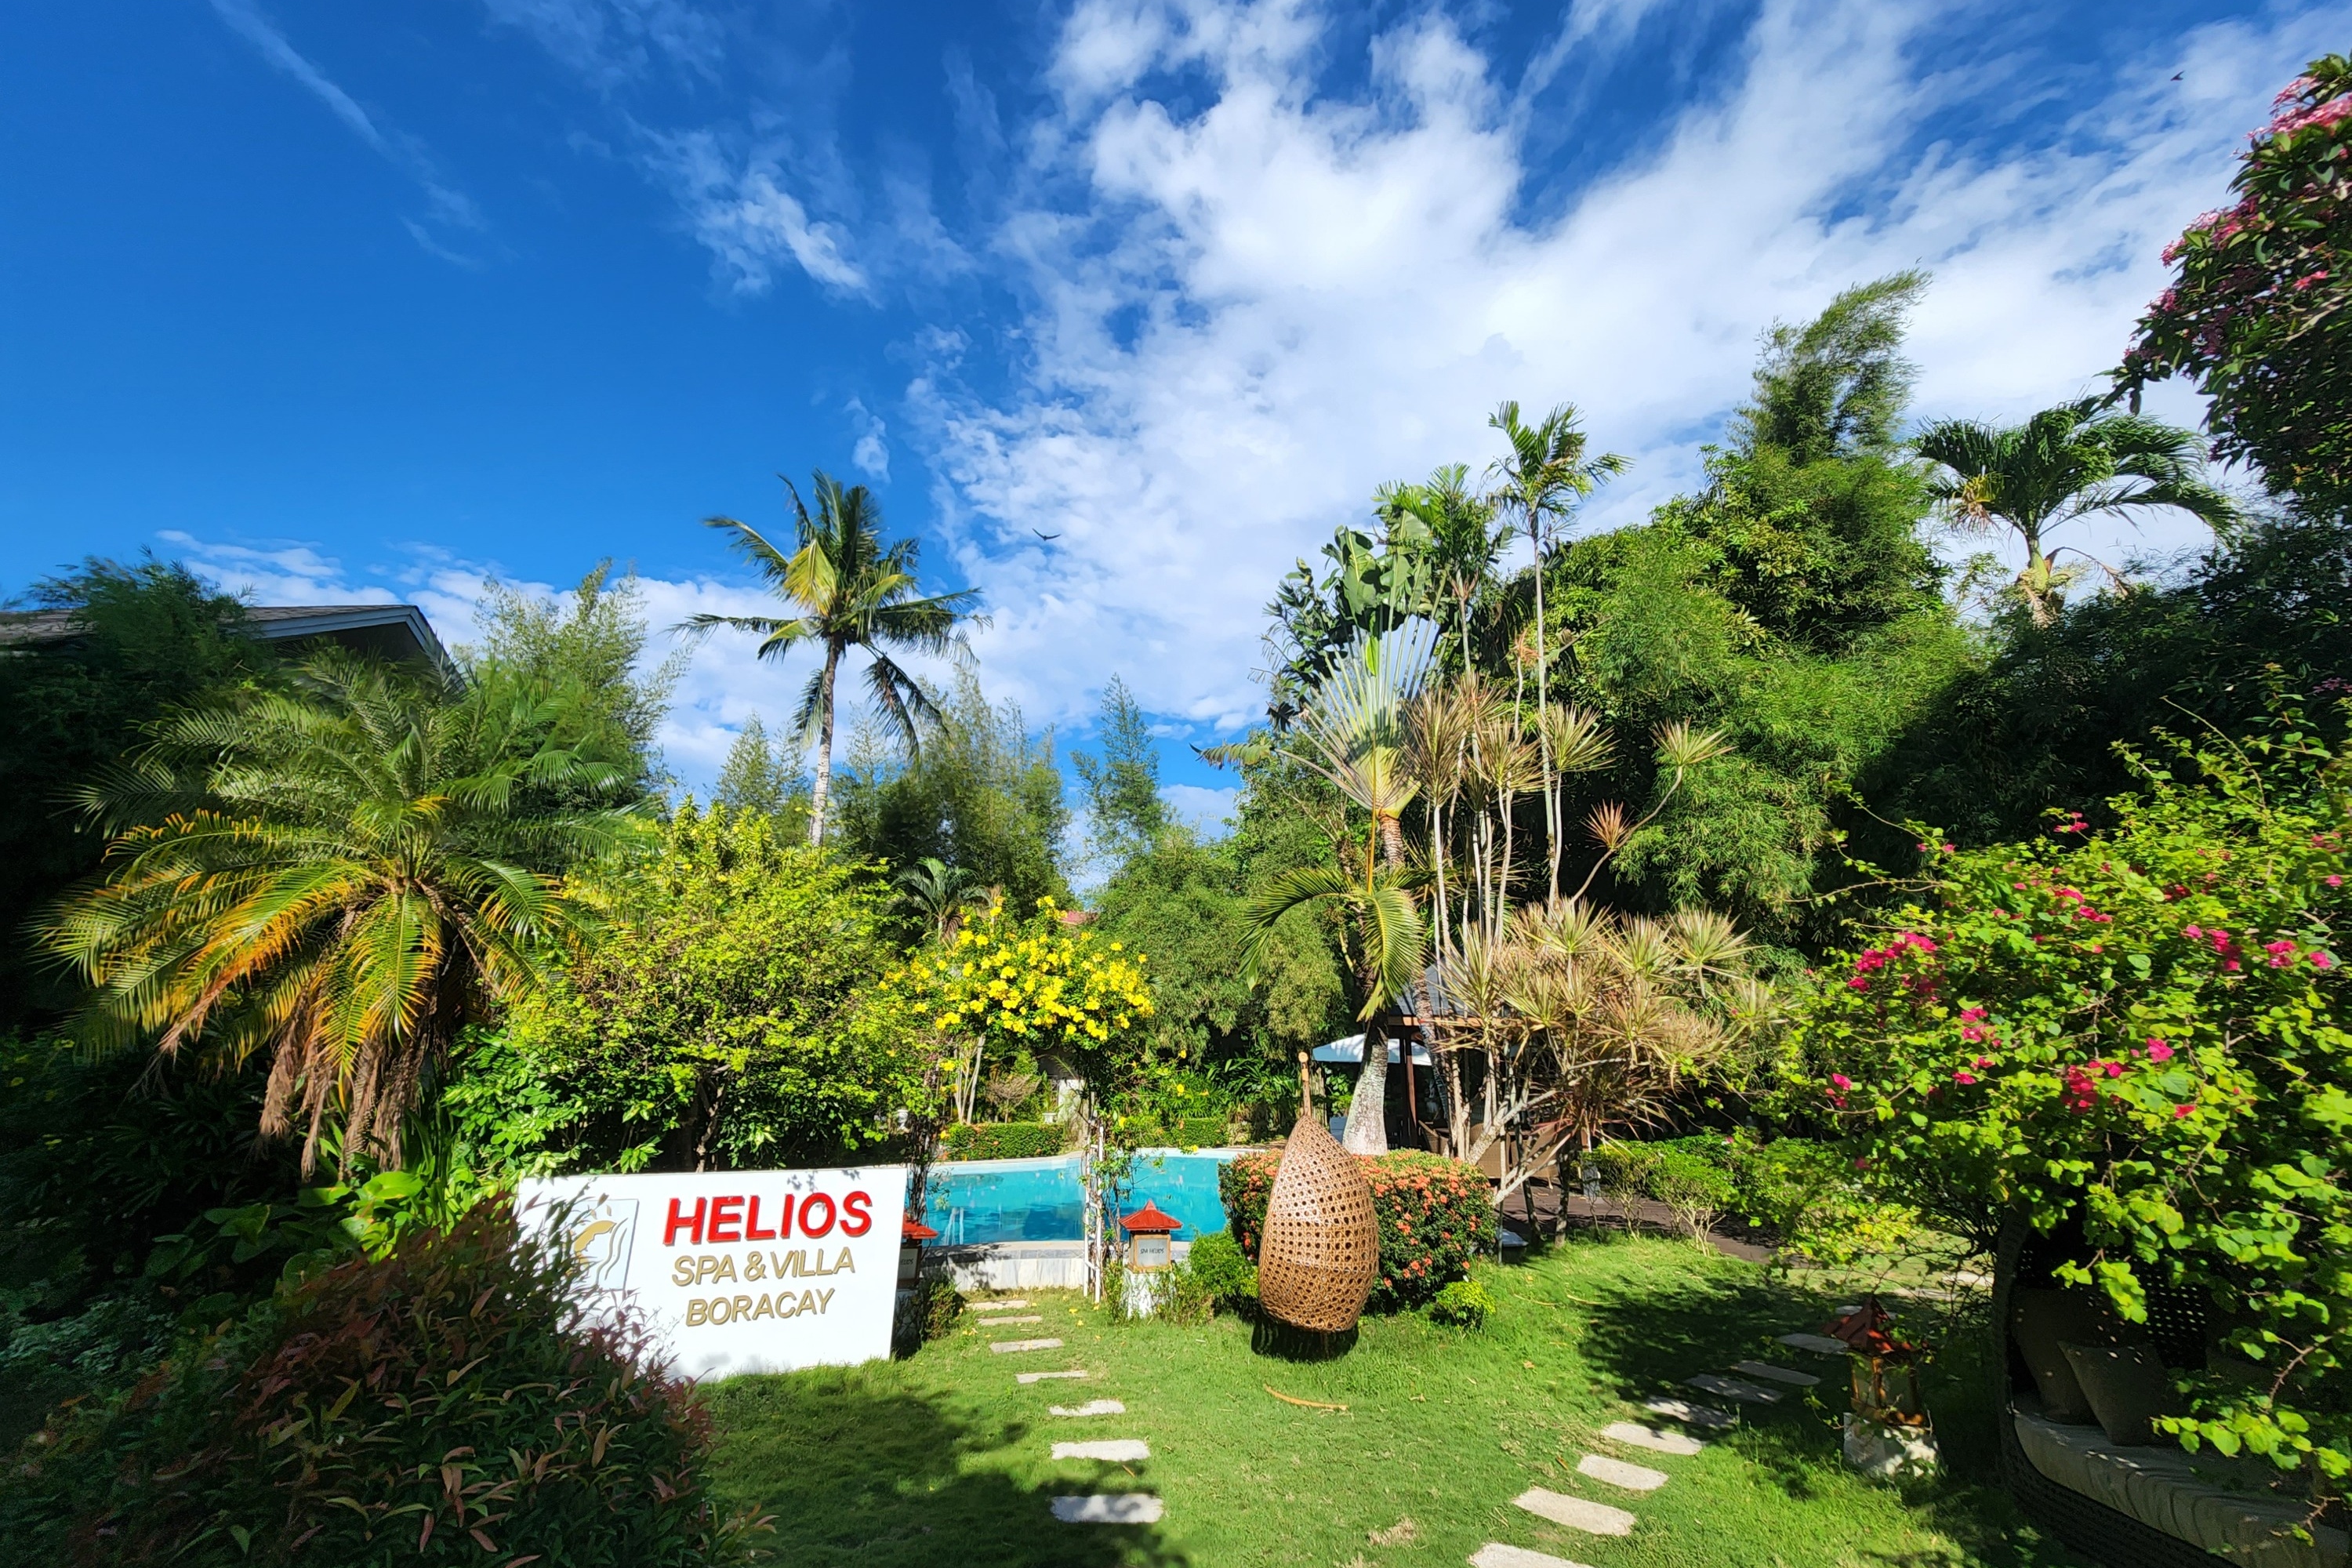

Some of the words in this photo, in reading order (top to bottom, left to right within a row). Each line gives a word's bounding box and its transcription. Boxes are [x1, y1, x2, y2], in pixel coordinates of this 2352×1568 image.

[663, 1191, 873, 1246] HELIOS
[672, 1254, 737, 1287] SPA
[744, 1251, 767, 1282] &
[771, 1247, 855, 1279] VILLA
[686, 1288, 835, 1327] BORACAY
